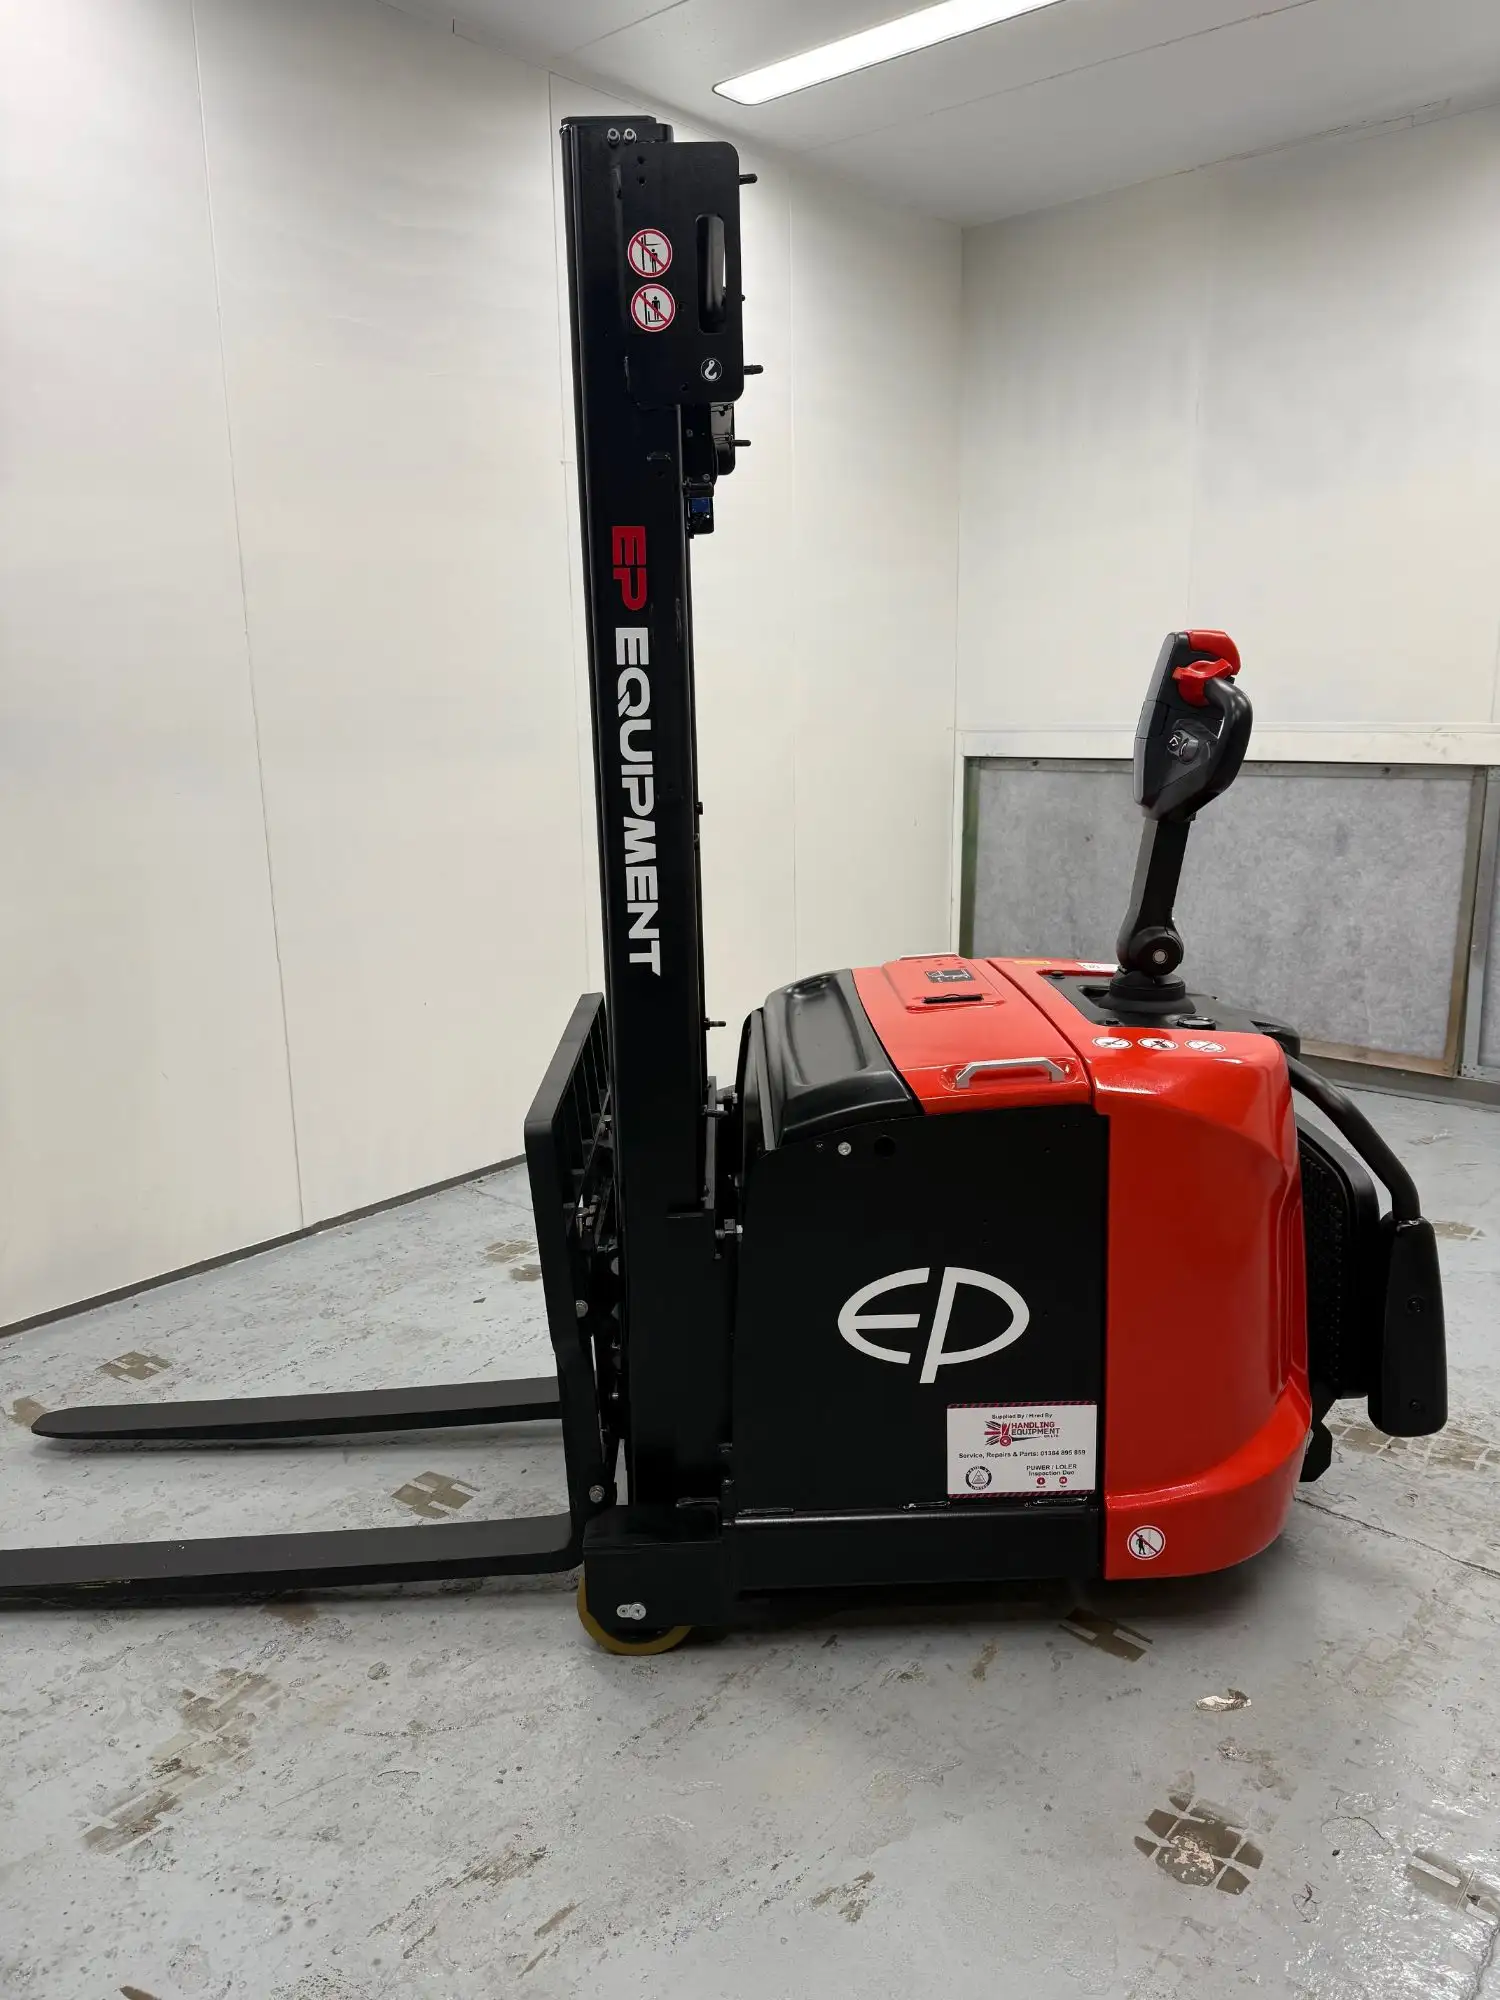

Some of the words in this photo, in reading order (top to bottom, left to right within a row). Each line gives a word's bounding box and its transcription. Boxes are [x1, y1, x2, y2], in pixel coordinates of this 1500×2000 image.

[612, 525, 647, 611] EP
[615, 626, 661, 977] EQUIPMENT
[837, 1266, 1030, 1384] EP
[1011, 1428, 1060, 1436] EQUIPMENT
